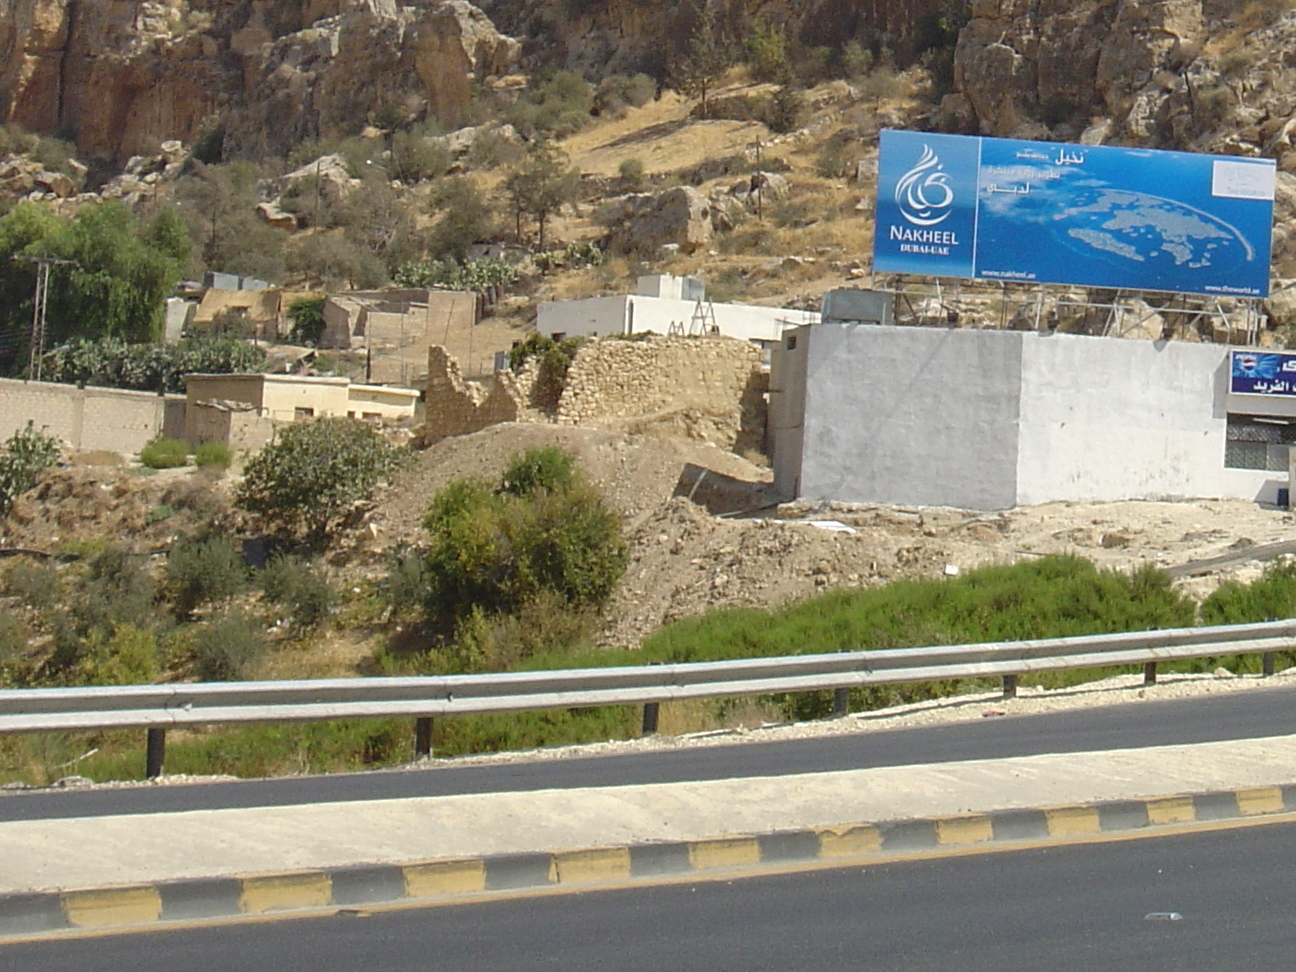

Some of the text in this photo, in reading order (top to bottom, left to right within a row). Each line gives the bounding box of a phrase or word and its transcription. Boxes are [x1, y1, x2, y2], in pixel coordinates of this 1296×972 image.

[890, 225, 959, 245] NAKHEEL
[900, 243, 949, 255] DUBAI-UAE
[981, 270, 1036, 279] www.nakheel.ae
